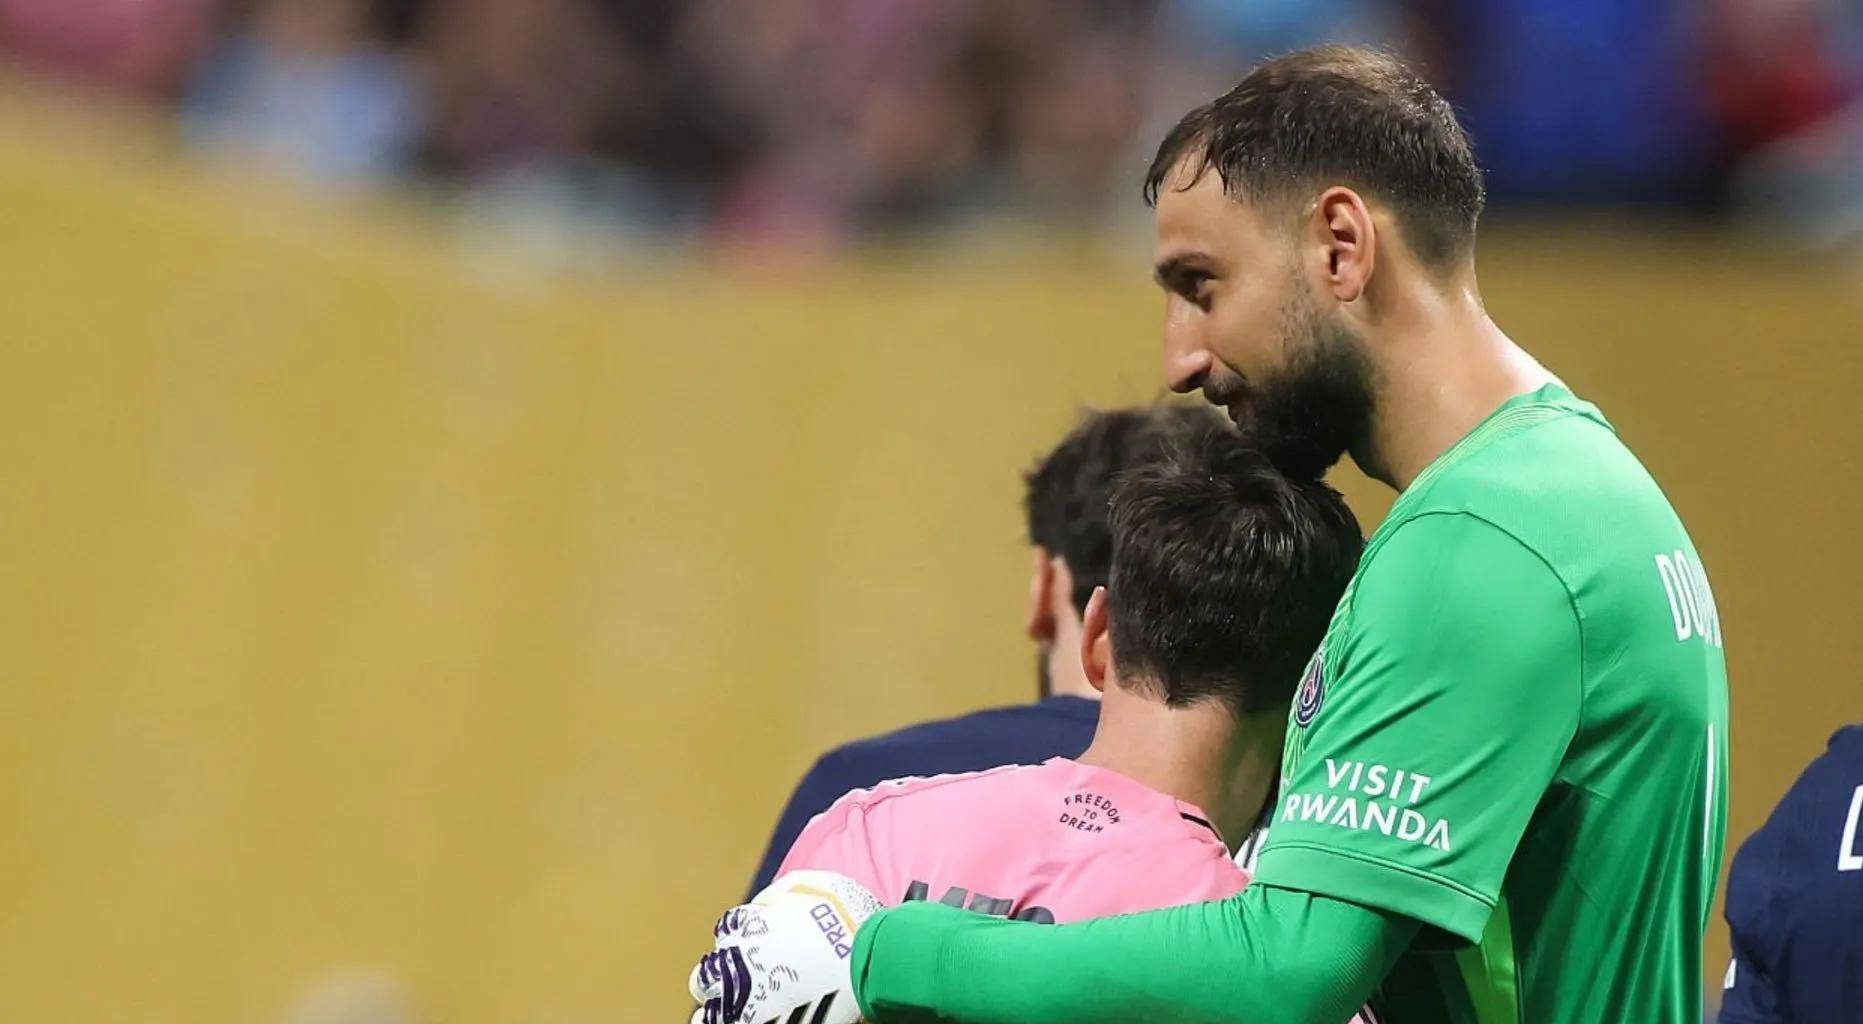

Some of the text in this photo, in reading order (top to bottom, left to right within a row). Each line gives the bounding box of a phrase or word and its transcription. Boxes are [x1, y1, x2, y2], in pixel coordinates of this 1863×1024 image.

[1325, 758, 1433, 805] VISIT
[1059, 812, 1105, 833] DREAM
[1063, 793, 1121, 825] FREEDOM
[1083, 808, 1098, 820] TO
[1280, 793, 1452, 852] RWANDA
[808, 903, 853, 960] PRED
